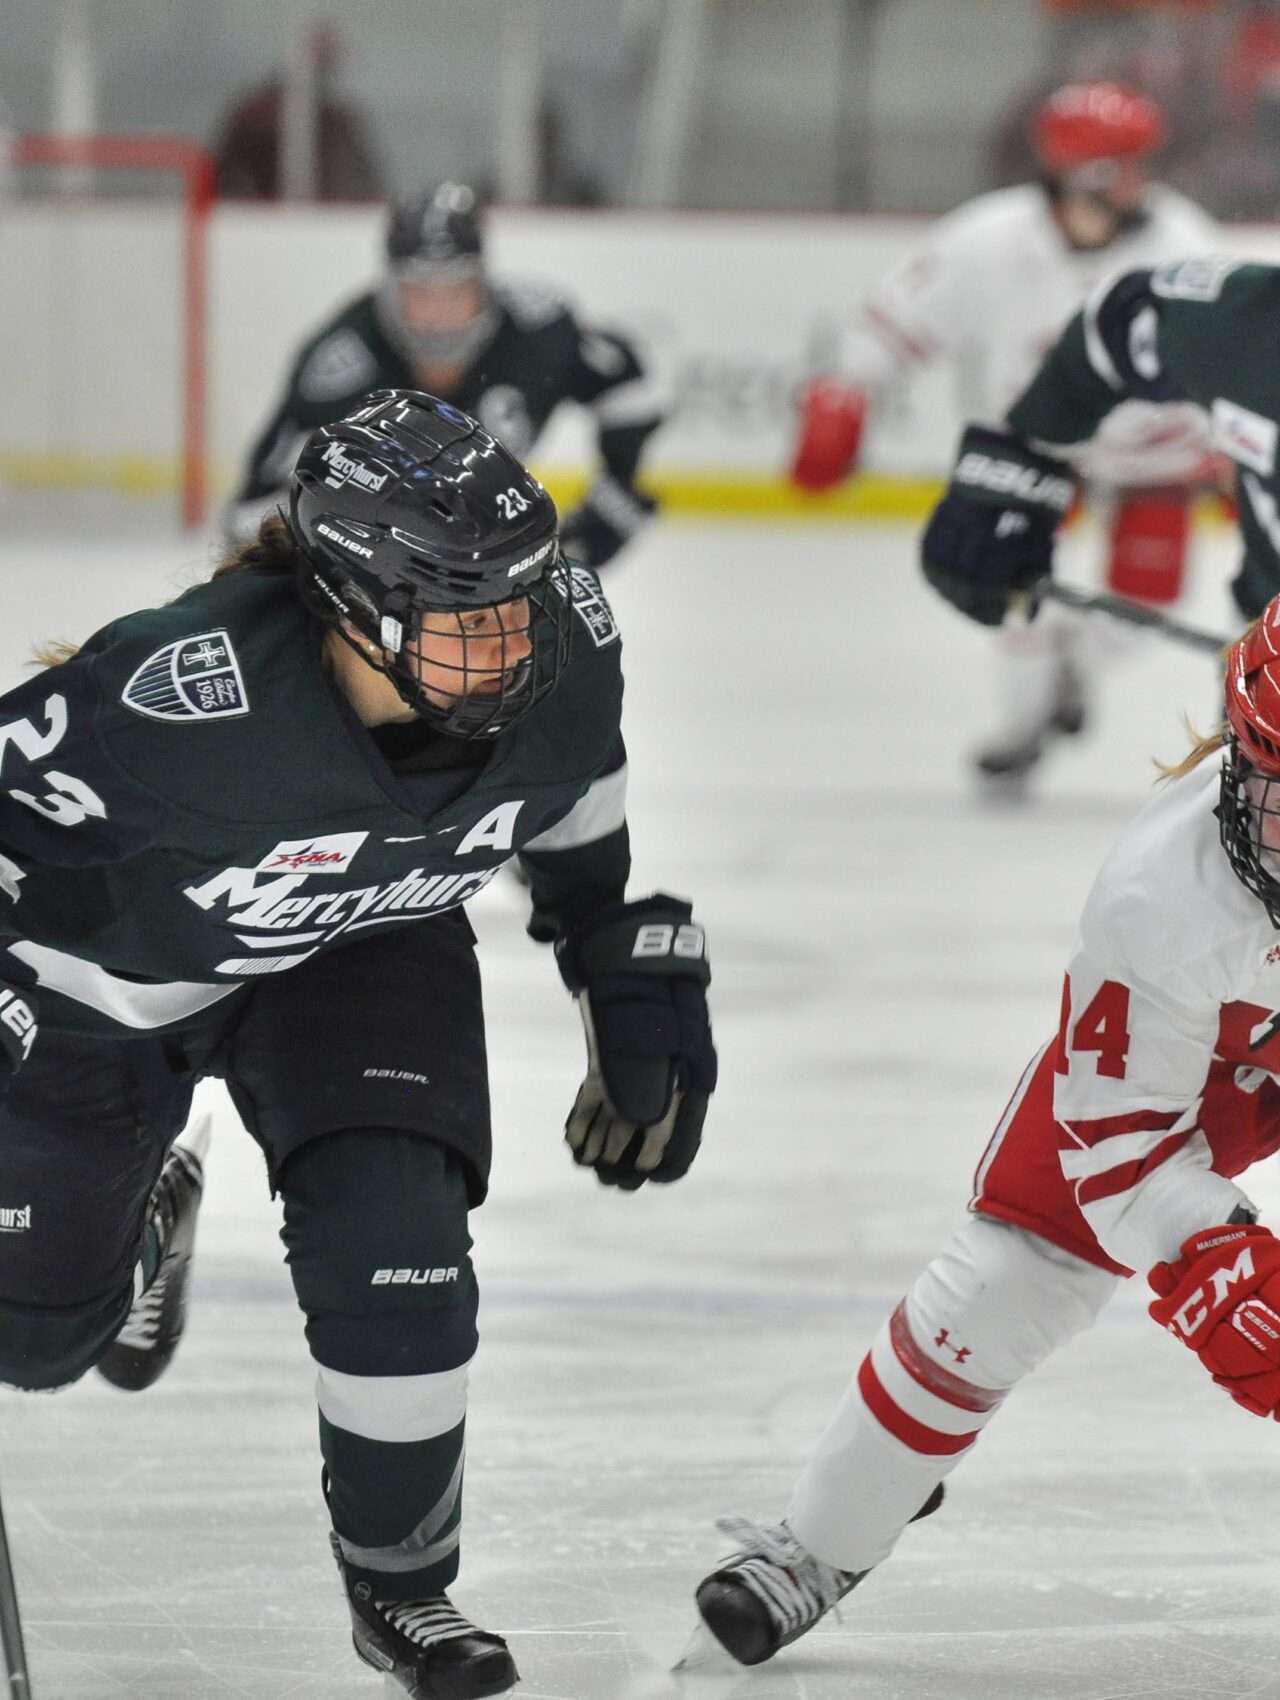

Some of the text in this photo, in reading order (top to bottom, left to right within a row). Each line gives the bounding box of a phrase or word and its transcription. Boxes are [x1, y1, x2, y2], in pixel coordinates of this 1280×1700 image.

[312, 441, 389, 492] Mercyhurst
[497, 487, 532, 521] 23
[316, 523, 375, 560] BAUER
[196, 679, 220, 710] 1926
[454, 800, 525, 857] A
[363, 1067, 430, 1085] BAUER
[370, 1266, 460, 1286] BAUER
[1168, 1247, 1256, 1341] CM
